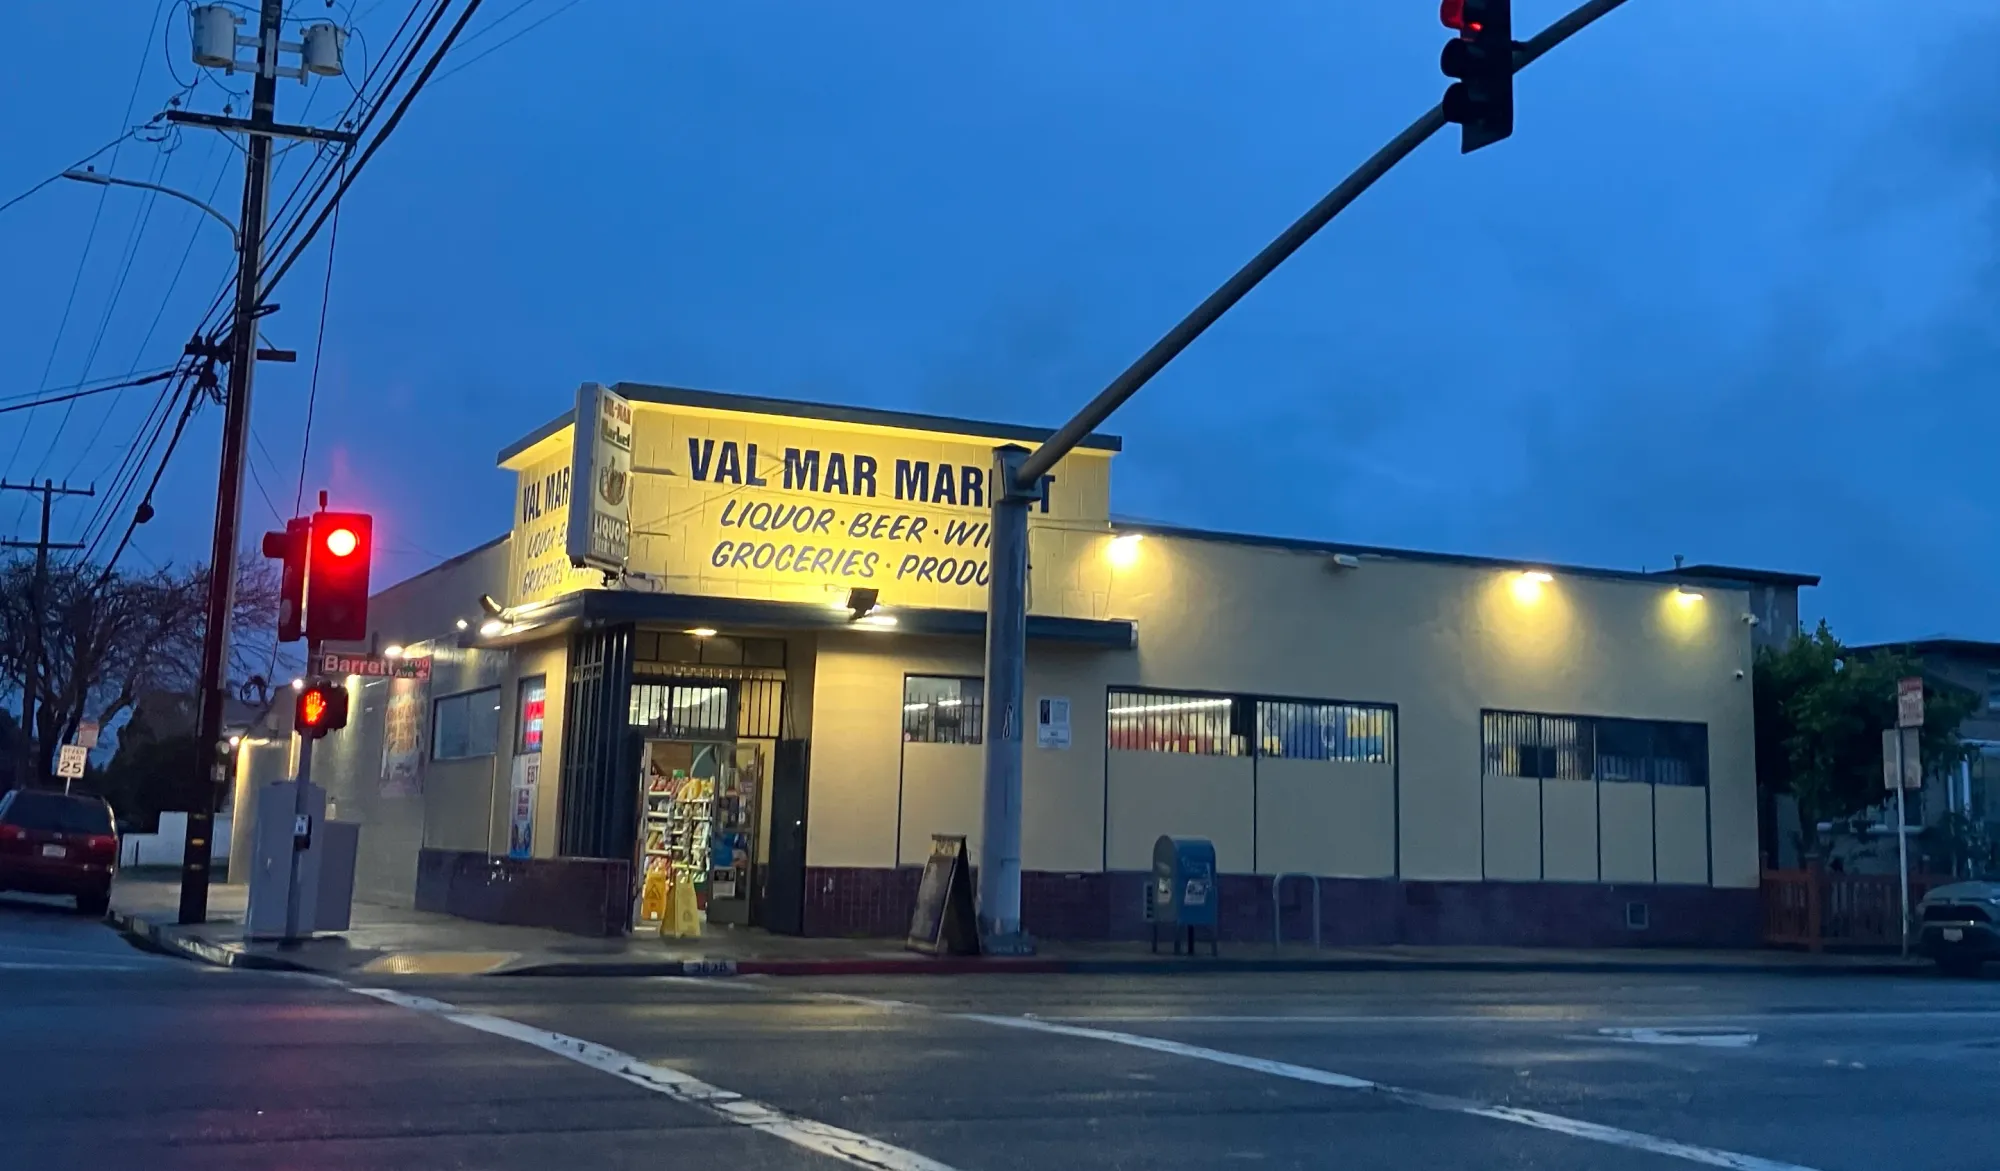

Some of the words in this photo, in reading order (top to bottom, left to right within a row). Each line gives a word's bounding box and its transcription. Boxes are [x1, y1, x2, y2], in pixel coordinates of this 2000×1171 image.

[523, 481, 541, 524] VAL
[545, 466, 570, 515] MAR
[688, 437, 768, 487] VAL
[782, 447, 878, 498] MAR
[894, 459, 1056, 514] MART
[720, 498, 835, 535] LIQUOR
[847, 511, 928, 544] BEER
[711, 540, 880, 579] GROCERIES
[324, 654, 394, 676] Barrett
[394, 668, 414, 678] Ave
[60, 761, 82, 774] 25
